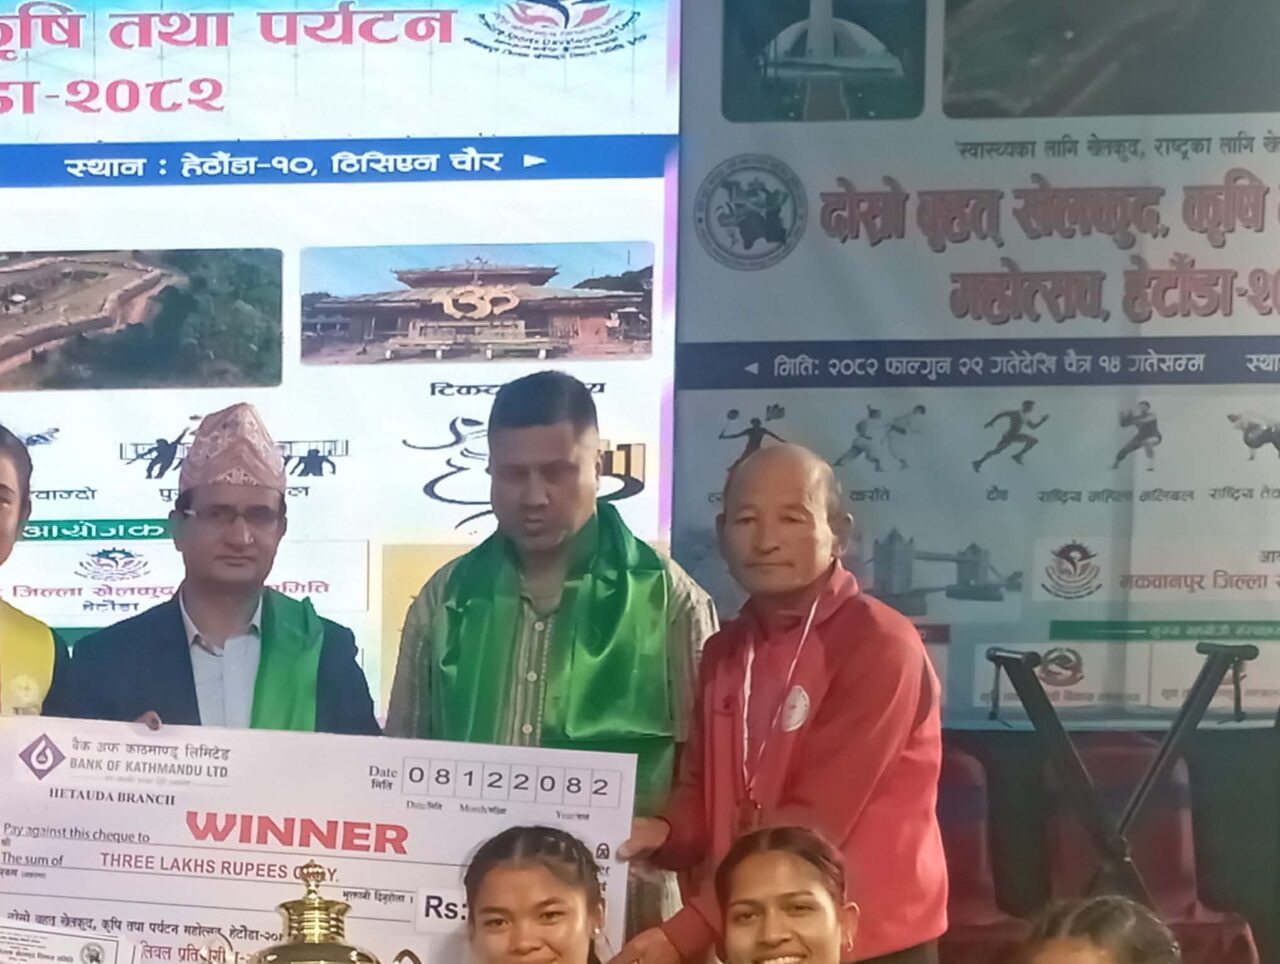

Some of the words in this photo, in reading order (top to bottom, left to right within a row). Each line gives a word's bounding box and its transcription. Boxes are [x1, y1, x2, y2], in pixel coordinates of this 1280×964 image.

[109, 10, 230, 48] तथा
[258, 0, 455, 46] पर्यटन
[64, 158, 147, 178] स्थान
[450, 147, 502, 172] चौर
[819, 176, 910, 246] दोस्रो
[1182, 168, 1269, 247] कृषि
[828, 357, 877, 377] २०८२
[885, 355, 951, 381] फाल्गुन
[70, 757, 102, 771] BANK
[107, 760, 121, 772] OF
[125, 761, 202, 777] KATHMANDU
[207, 766, 228, 778] LTD
[369, 765, 398, 779] Date
[49, 787, 114, 803] HETAUDA
[118, 791, 176, 806] BRANCH
[3, 822, 23, 838] Pay
[26, 825, 66, 839] against
[70, 826, 90, 840] this
[92, 829, 136, 846] cheque
[138, 832, 150, 843] to
[186, 810, 409, 855] WINNER
[1, 852, 22, 864] The
[25, 854, 48, 866] sum
[51, 855, 64, 867] of
[101, 852, 156, 870] THREE
[160, 856, 215, 875] LAKHS
[221, 860, 288, 880] RUPEES
[424, 895, 467, 921] Rs:
[149, 919, 179, 935] पर्यटन
